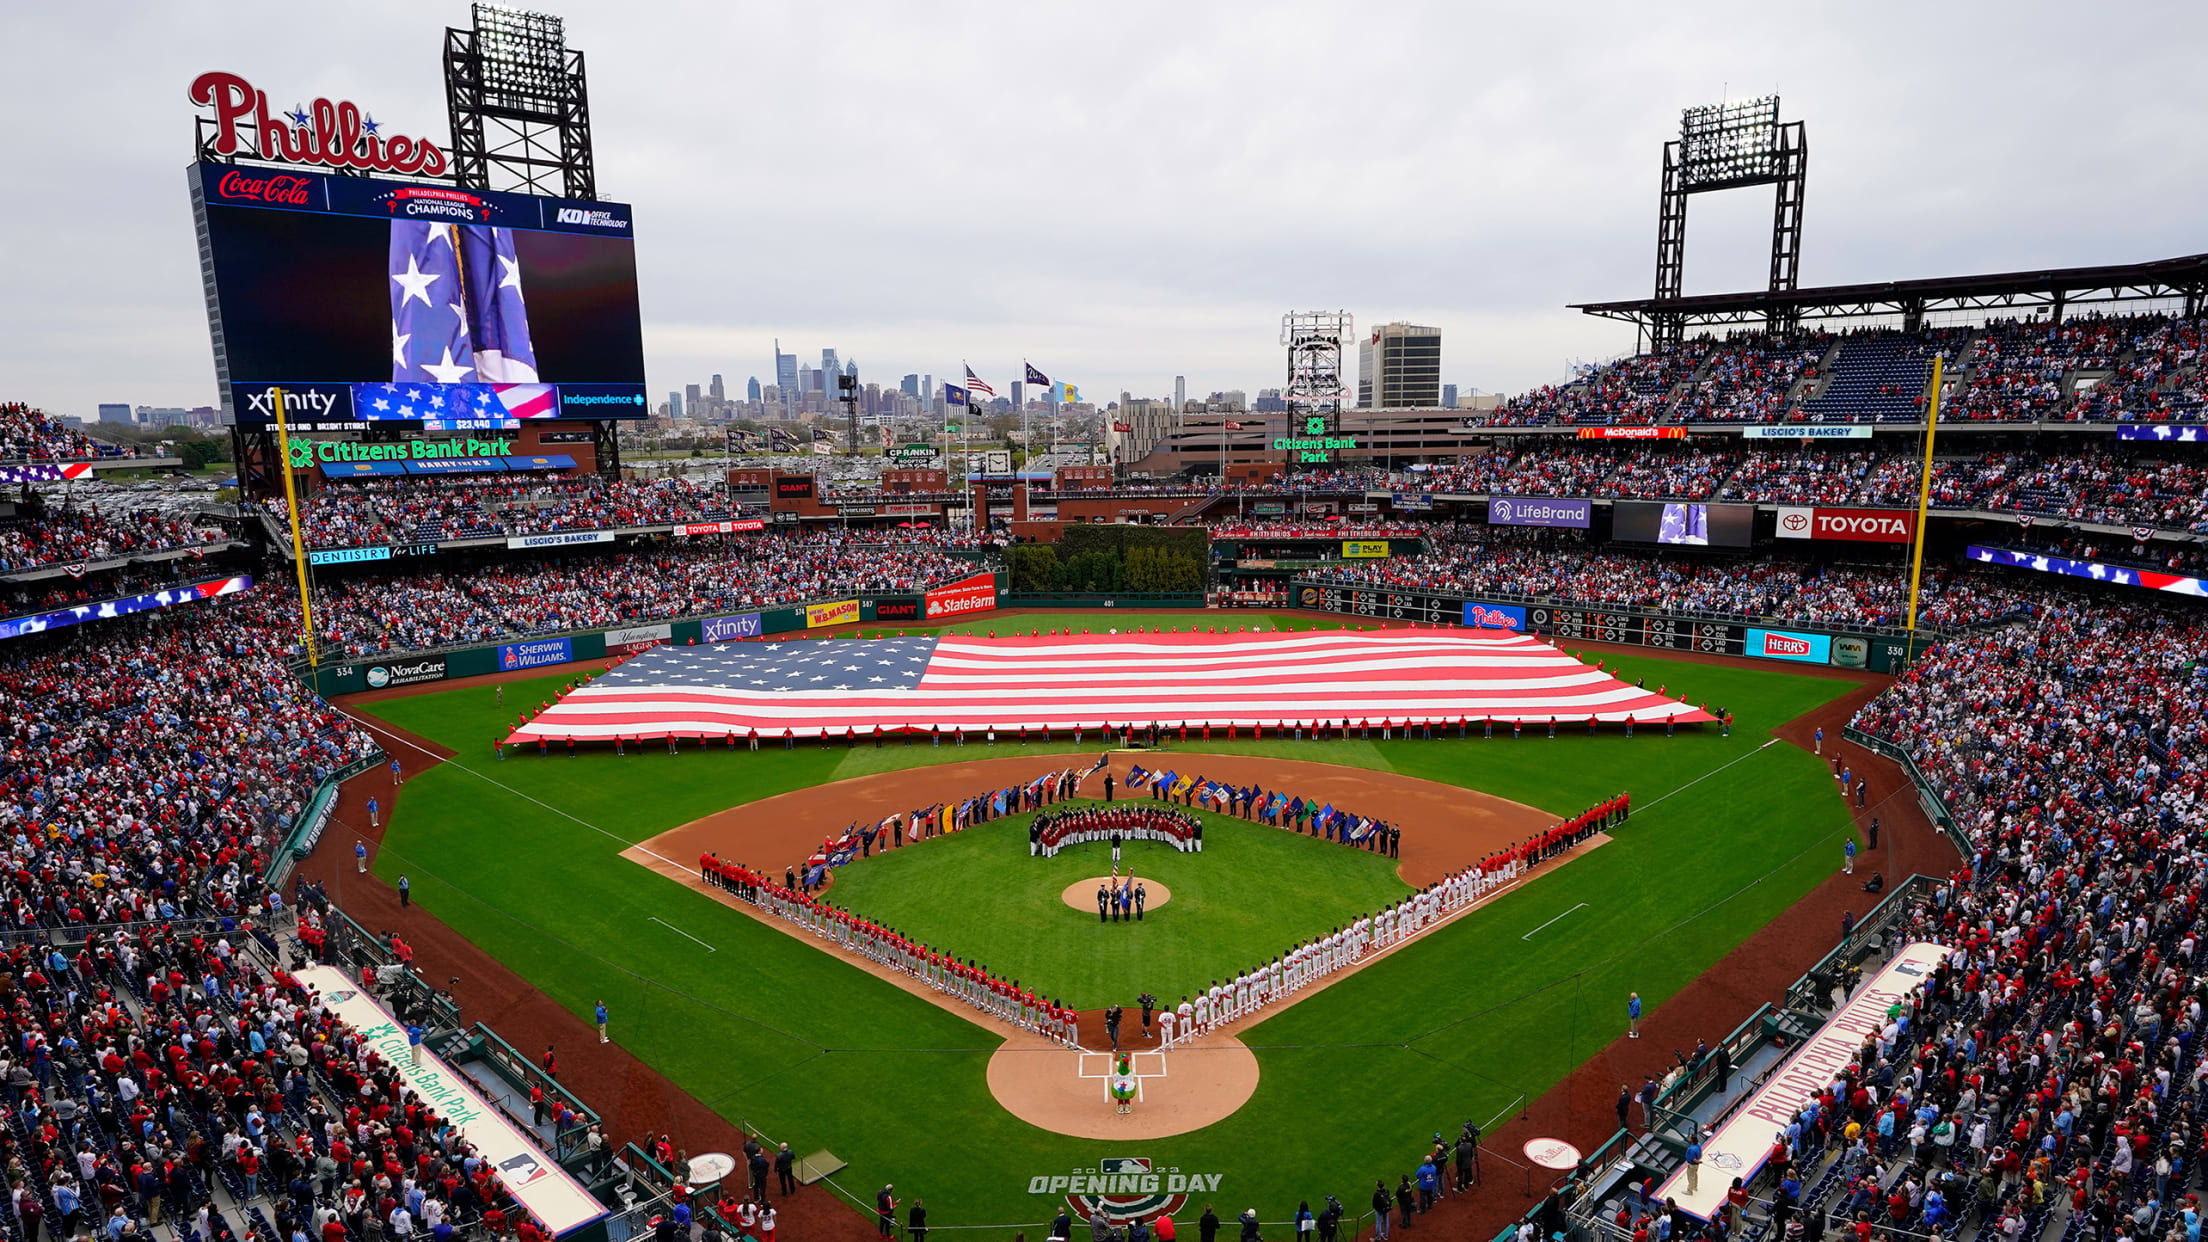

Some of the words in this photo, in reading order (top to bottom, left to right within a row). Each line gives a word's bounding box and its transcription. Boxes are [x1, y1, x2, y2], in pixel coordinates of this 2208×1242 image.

[189, 72, 447, 176] Phillies
[219, 171, 312, 204] Coca-Cola
[408, 189, 444, 198] PHILADELPHIA
[446, 192, 468, 201] PHILLIES
[444, 200, 466, 208] LEAGUE
[406, 203, 474, 220] CHAMPIONS
[591, 211, 612, 219] OFFICE
[590, 218, 628, 229] TECHNOLOGY
[247, 387, 337, 416] xfnity
[564, 394, 632, 406] Independence
[1604, 428, 1659, 436] McDonald's
[1762, 427, 1806, 436] LISCIO'S
[1808, 427, 1852, 436] BAKERY
[318, 442, 408, 462] Citizens
[411, 439, 465, 459] Bank
[466, 437, 512, 457] Park
[1273, 437, 1323, 450] Citizens
[1325, 436, 1356, 449] Bank
[1301, 450, 1328, 463] Park
[417, 460, 457, 469] HARRY
[472, 459, 492, 467] K'S
[780, 484, 809, 492] GIANT
[1516, 505, 1584, 520] LifeBrand
[687, 526, 719, 534] TOYOTA
[732, 522, 762, 530] TOYOTA
[1818, 516, 1907, 535] TOYOTA
[524, 535, 563, 547] LISCIO'S
[564, 533, 598, 544] BAKERY
[311, 548, 387, 563] DENTISTRY
[392, 547, 407, 557] for
[409, 544, 437, 556] LIFE
[877, 605, 916, 614] GIANT
[943, 598, 970, 613] State
[970, 595, 995, 608] Farm
[1472, 606, 1517, 627] Phillies
[706, 617, 758, 640] xfinity
[618, 631, 658, 642] Yuengling
[519, 641, 564, 656] SHERWIN
[1768, 638, 1806, 653] HERR'S
[1887, 646, 1904, 656] 330
[336, 666, 353, 677] 334
[390, 661, 446, 678] NovaCare
[391, 672, 444, 685] REHABILITATION
[1835, 988, 1903, 1036] PHILLIES
[379, 1039, 426, 1077] Citizens
[414, 1072, 457, 1102] Bank
[440, 1096, 481, 1125] Park
[1028, 1174, 1159, 1194] OPENING
[1167, 1173, 1224, 1193] DAY
